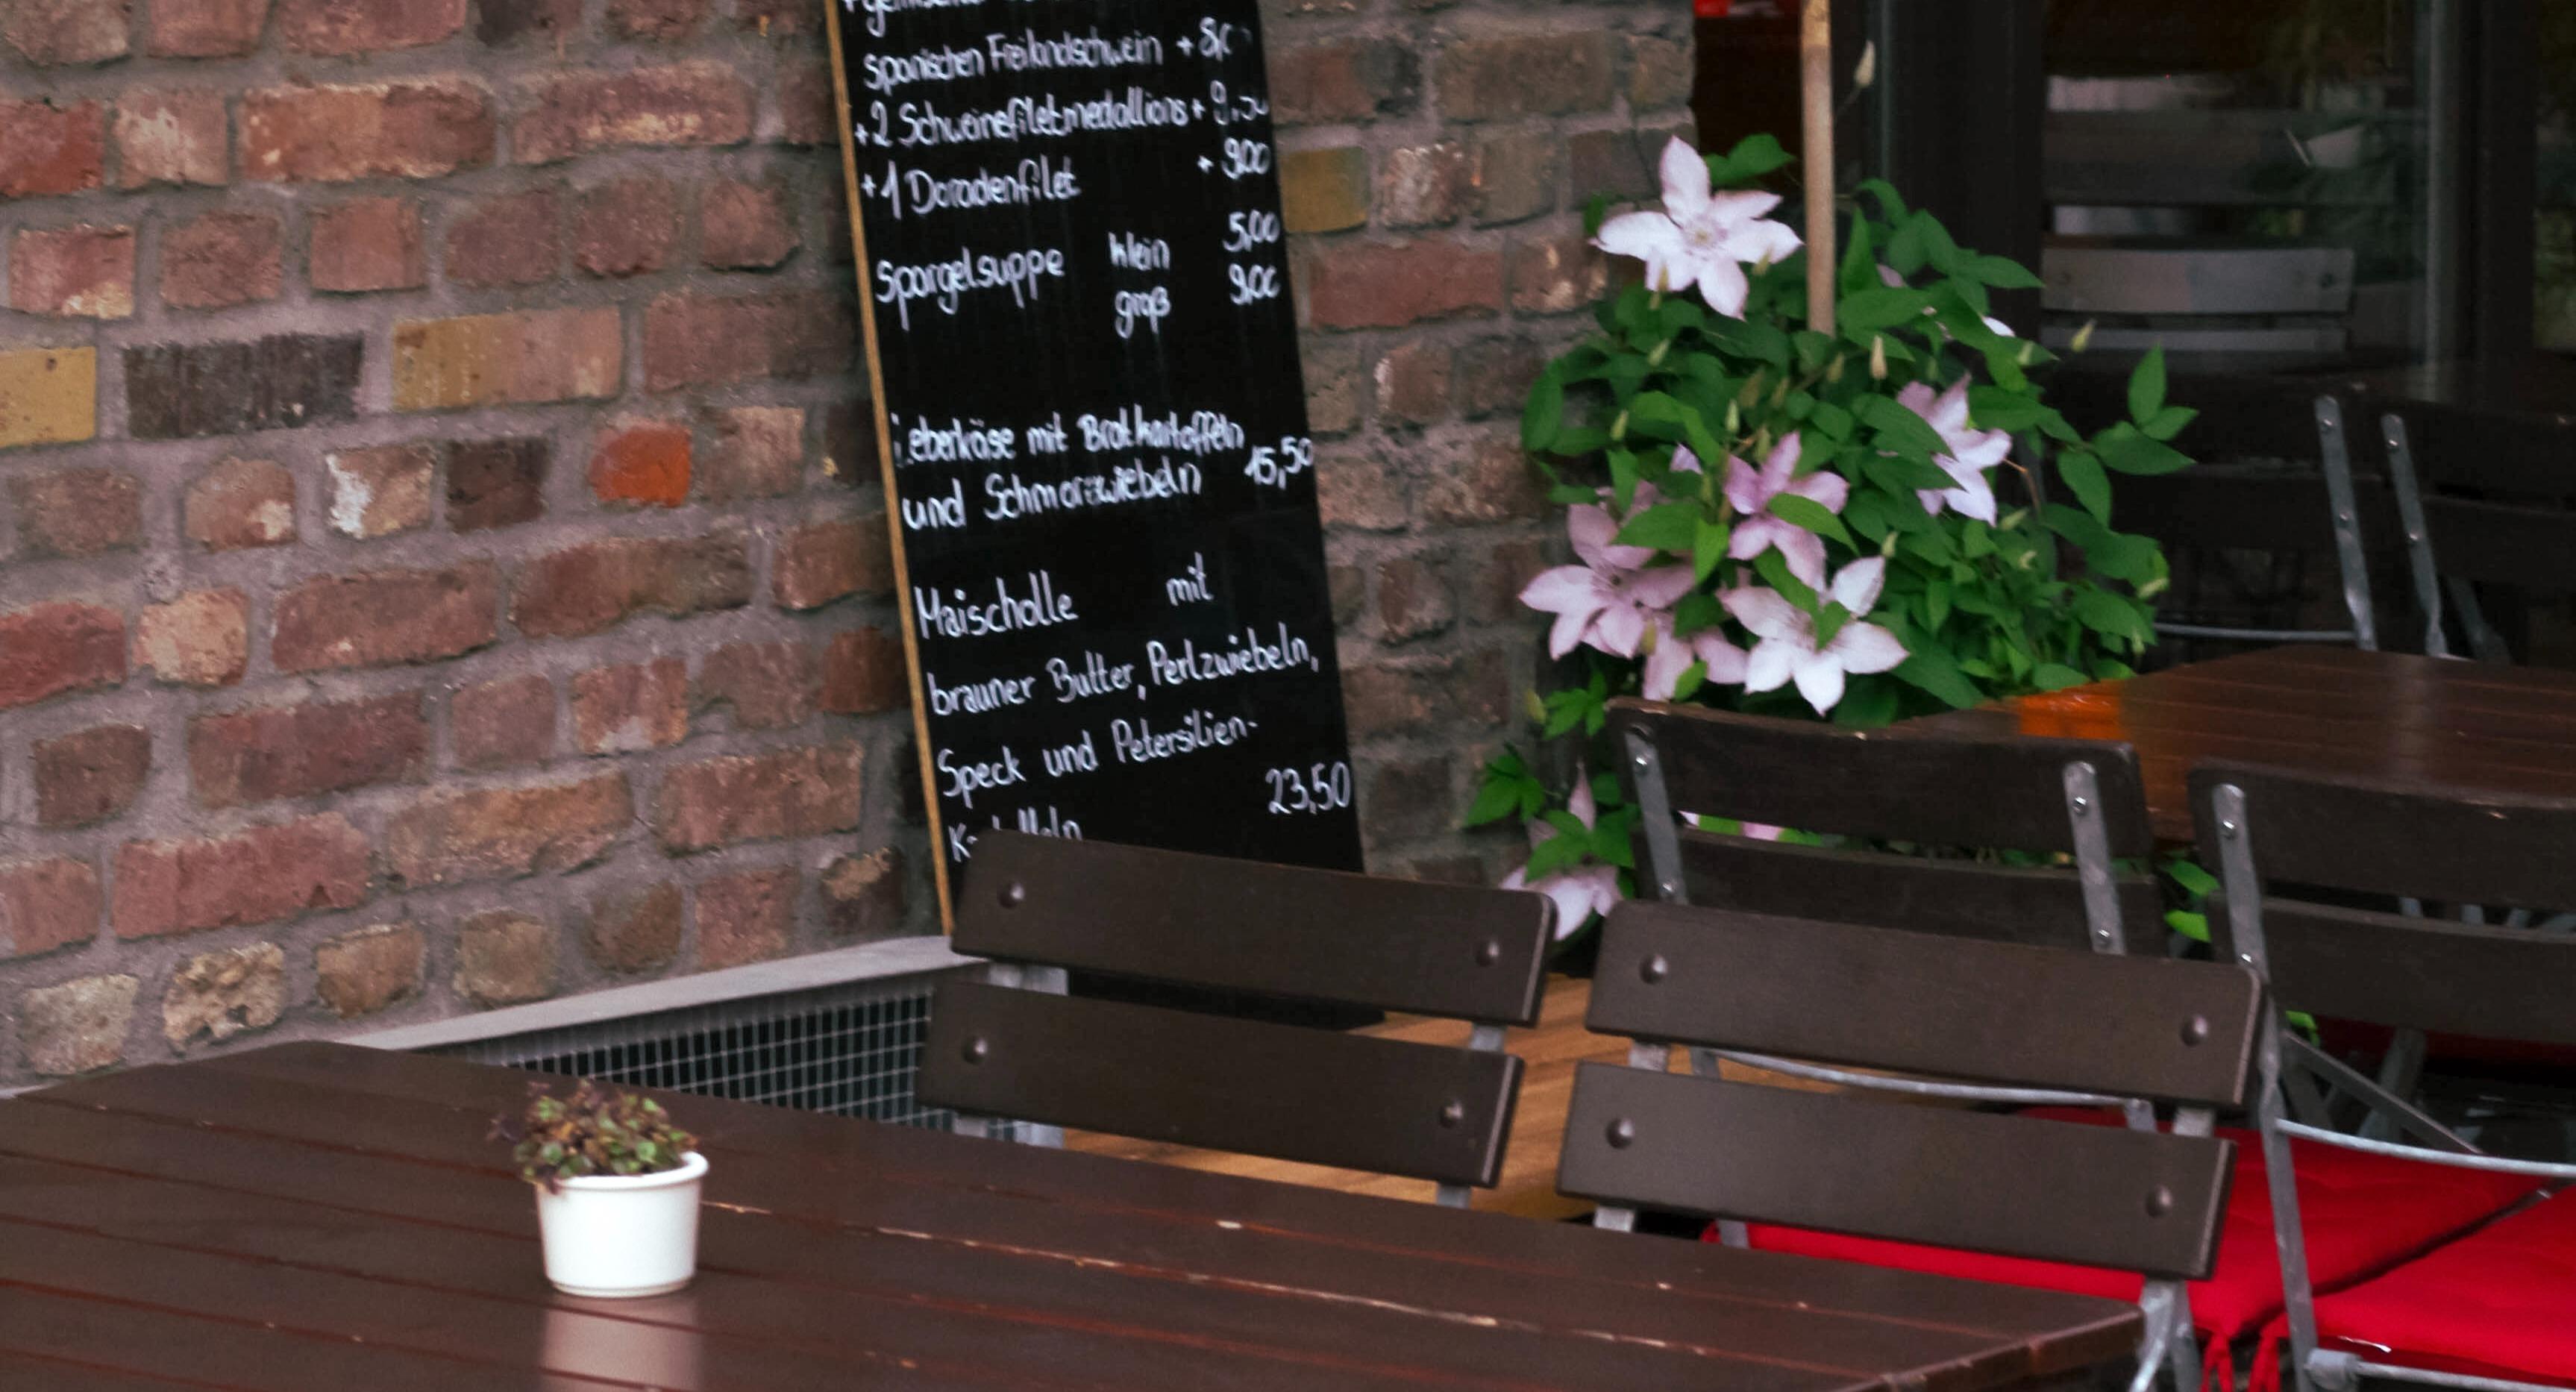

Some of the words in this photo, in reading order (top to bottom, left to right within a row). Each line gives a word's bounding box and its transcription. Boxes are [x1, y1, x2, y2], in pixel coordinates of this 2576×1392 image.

[904, 155, 1080, 214] Doradenfilet
[875, 246, 1065, 331] Spargelsuppe
[1109, 232, 1170, 271] klein
[1223, 210, 1279, 252] 5,00
[1115, 286, 1171, 339] groß
[1229, 263, 1279, 305] 9,00
[1027, 412, 1068, 455] mit
[902, 477, 967, 530] und
[1244, 436, 1314, 489] 15,50
[914, 570, 1079, 639] Maischolle
[1166, 552, 1213, 606] mit
[927, 673, 1035, 715] brauner
[1046, 651, 1146, 703] Butter,
[1147, 622, 1318, 685] Perlzwiebeln,
[937, 746, 1027, 809] Speck
[1043, 730, 1098, 777] und
[1111, 709, 1257, 762] Petersilien-
[1265, 762, 1350, 814] 23,50
